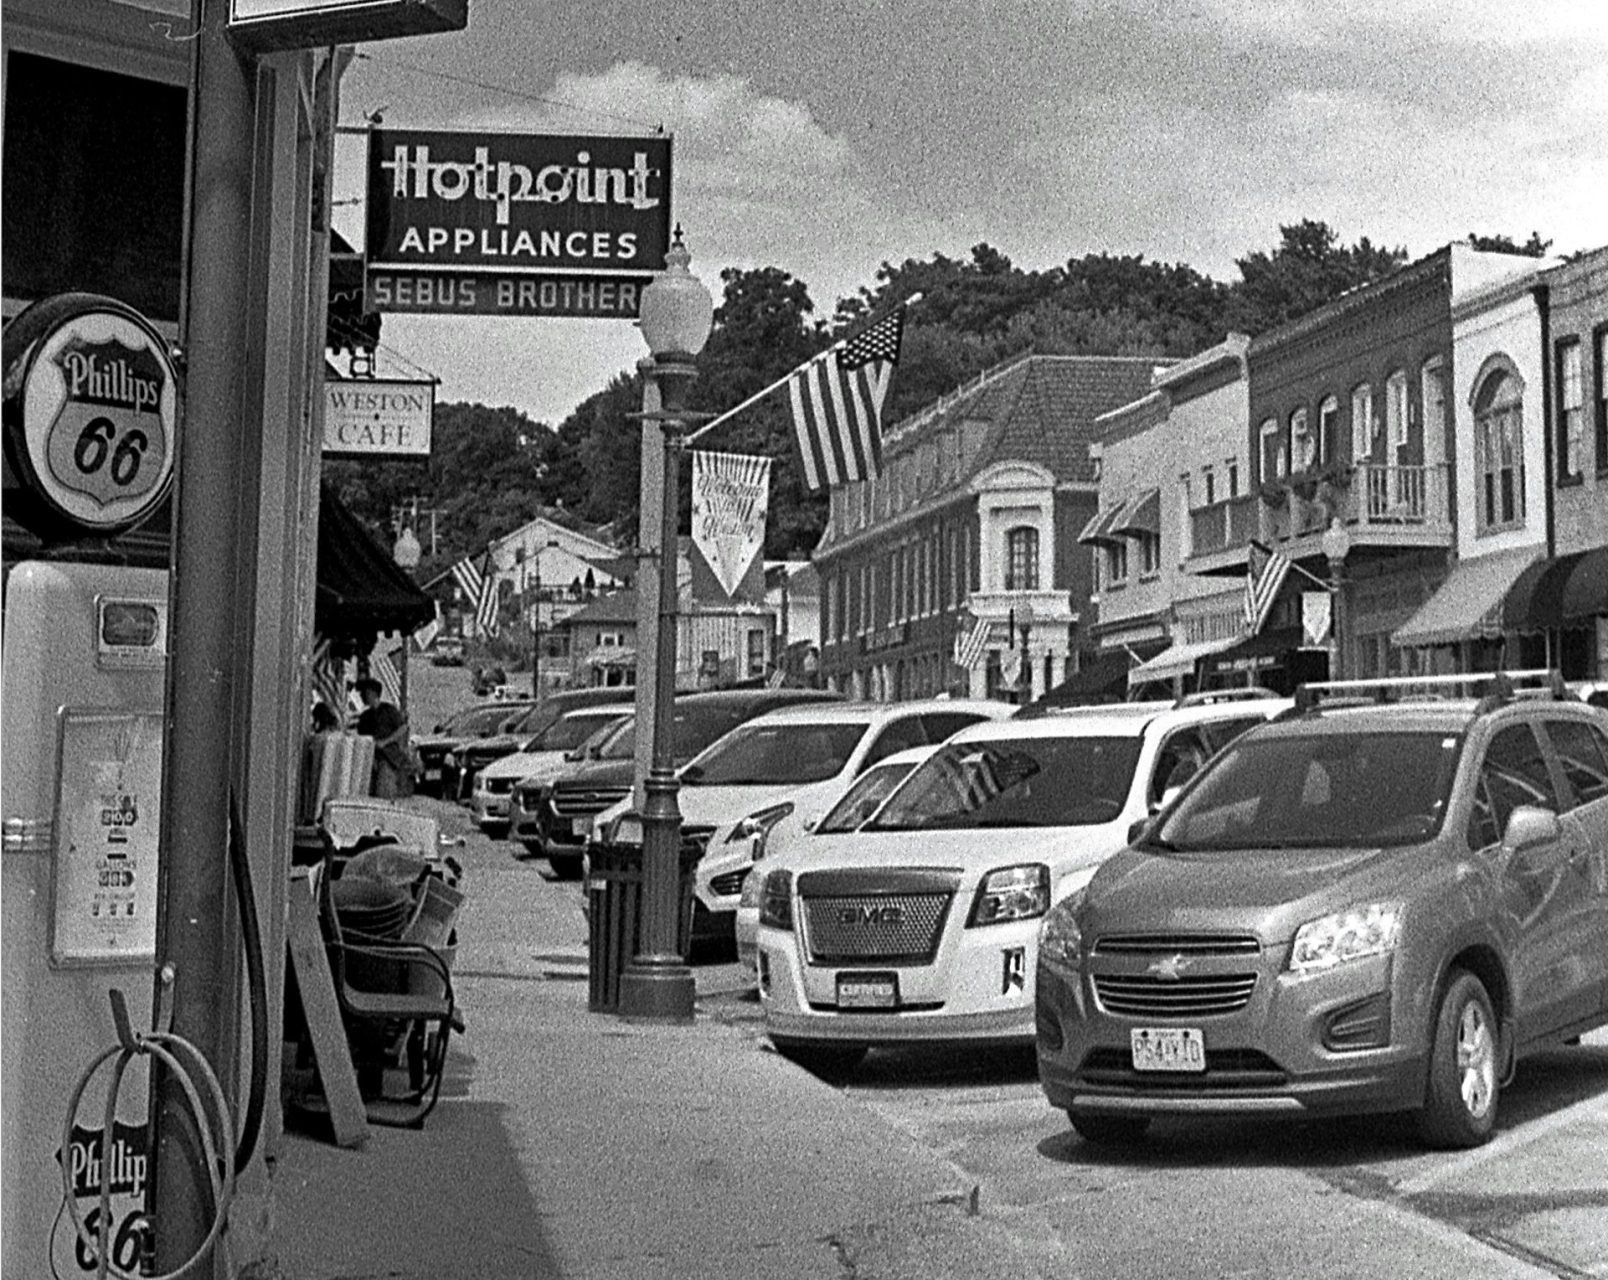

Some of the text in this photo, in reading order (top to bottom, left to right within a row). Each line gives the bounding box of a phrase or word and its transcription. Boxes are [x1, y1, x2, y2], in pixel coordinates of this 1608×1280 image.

[381, 145, 661, 224] Hotpoint
[398, 227, 637, 259] APPLIANCES
[374, 277, 637, 310] SEBUS BROTHER
[64, 351, 159, 417] Phillips
[330, 392, 423, 412] WESTON
[74, 417, 148, 486] 66
[338, 424, 412, 446] CAFE
[70, 1138, 147, 1197] Phllip
